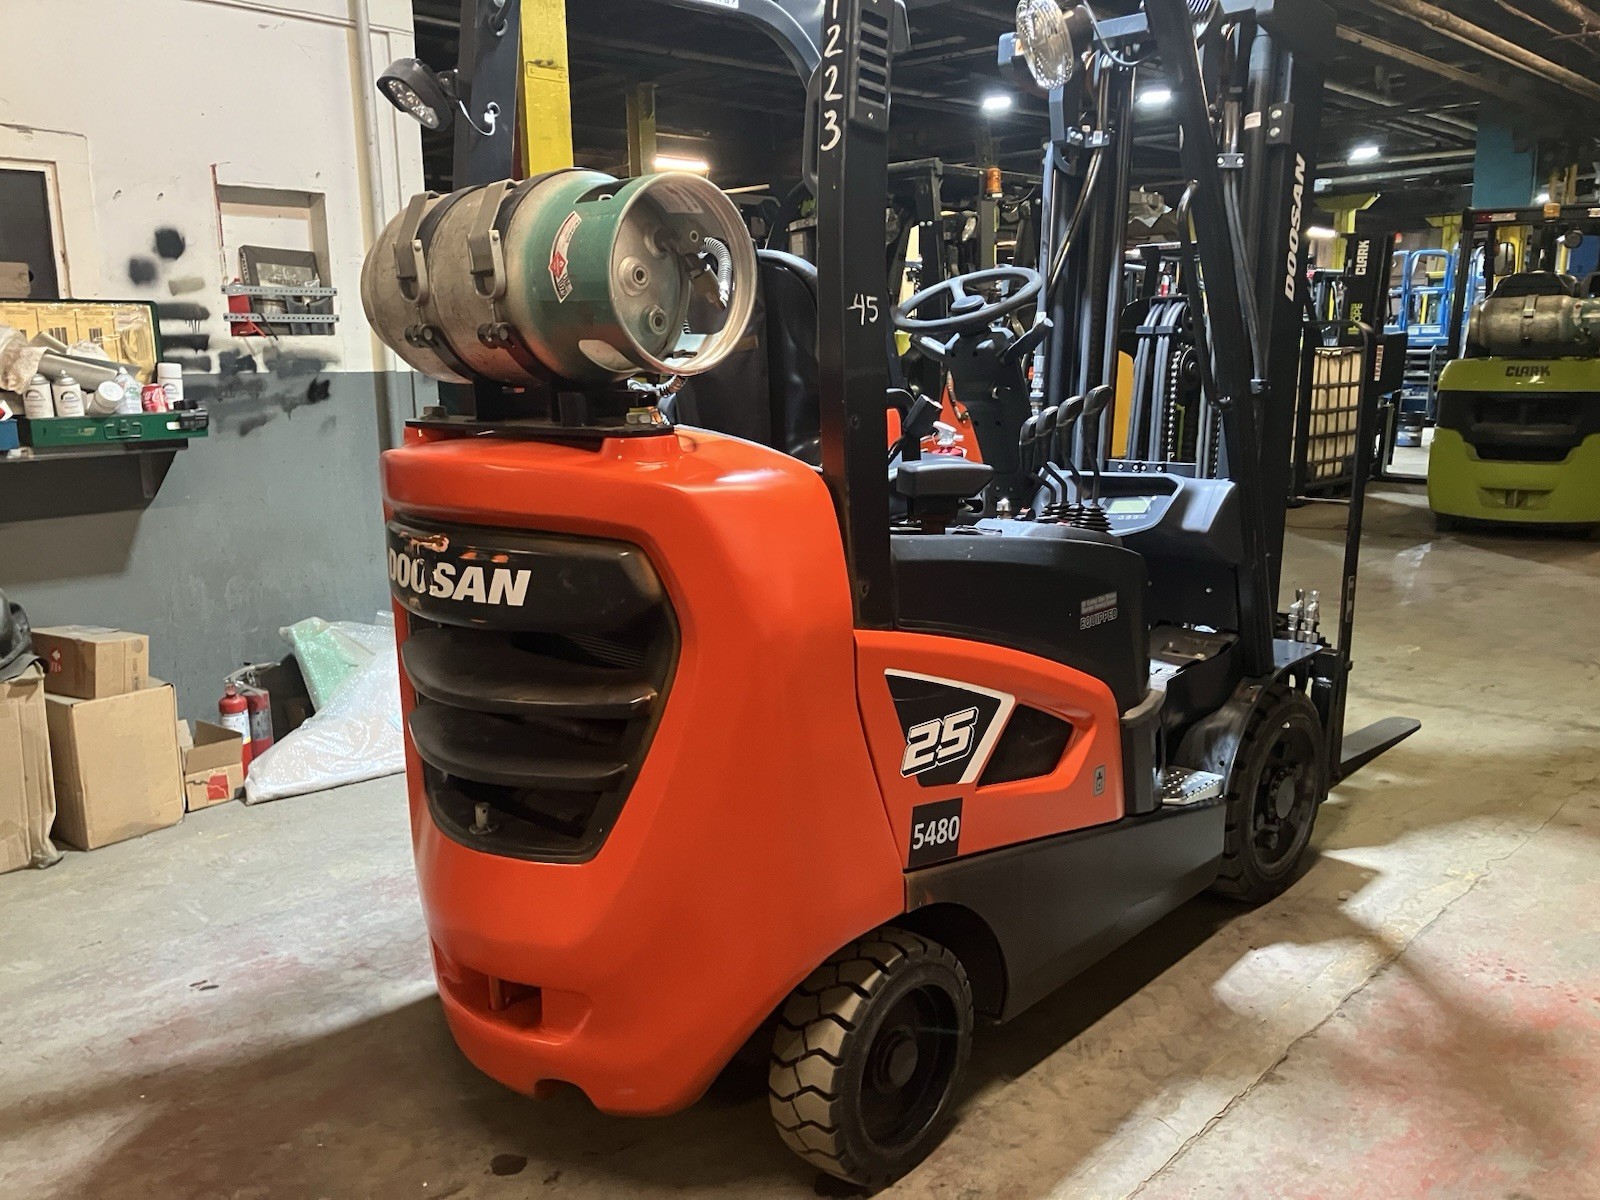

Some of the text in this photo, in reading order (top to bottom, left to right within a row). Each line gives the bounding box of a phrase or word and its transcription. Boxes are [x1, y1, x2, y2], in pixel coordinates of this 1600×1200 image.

[1284, 152, 1306, 302] DOOSAN
[1355, 240, 1370, 276] CLARK
[1505, 365, 1551, 377] CLARK
[389, 547, 532, 607] DOOSAN
[1080, 607, 1118, 631] EQUIPPED
[900, 706, 980, 779] 25
[912, 815, 961, 850] 5480
